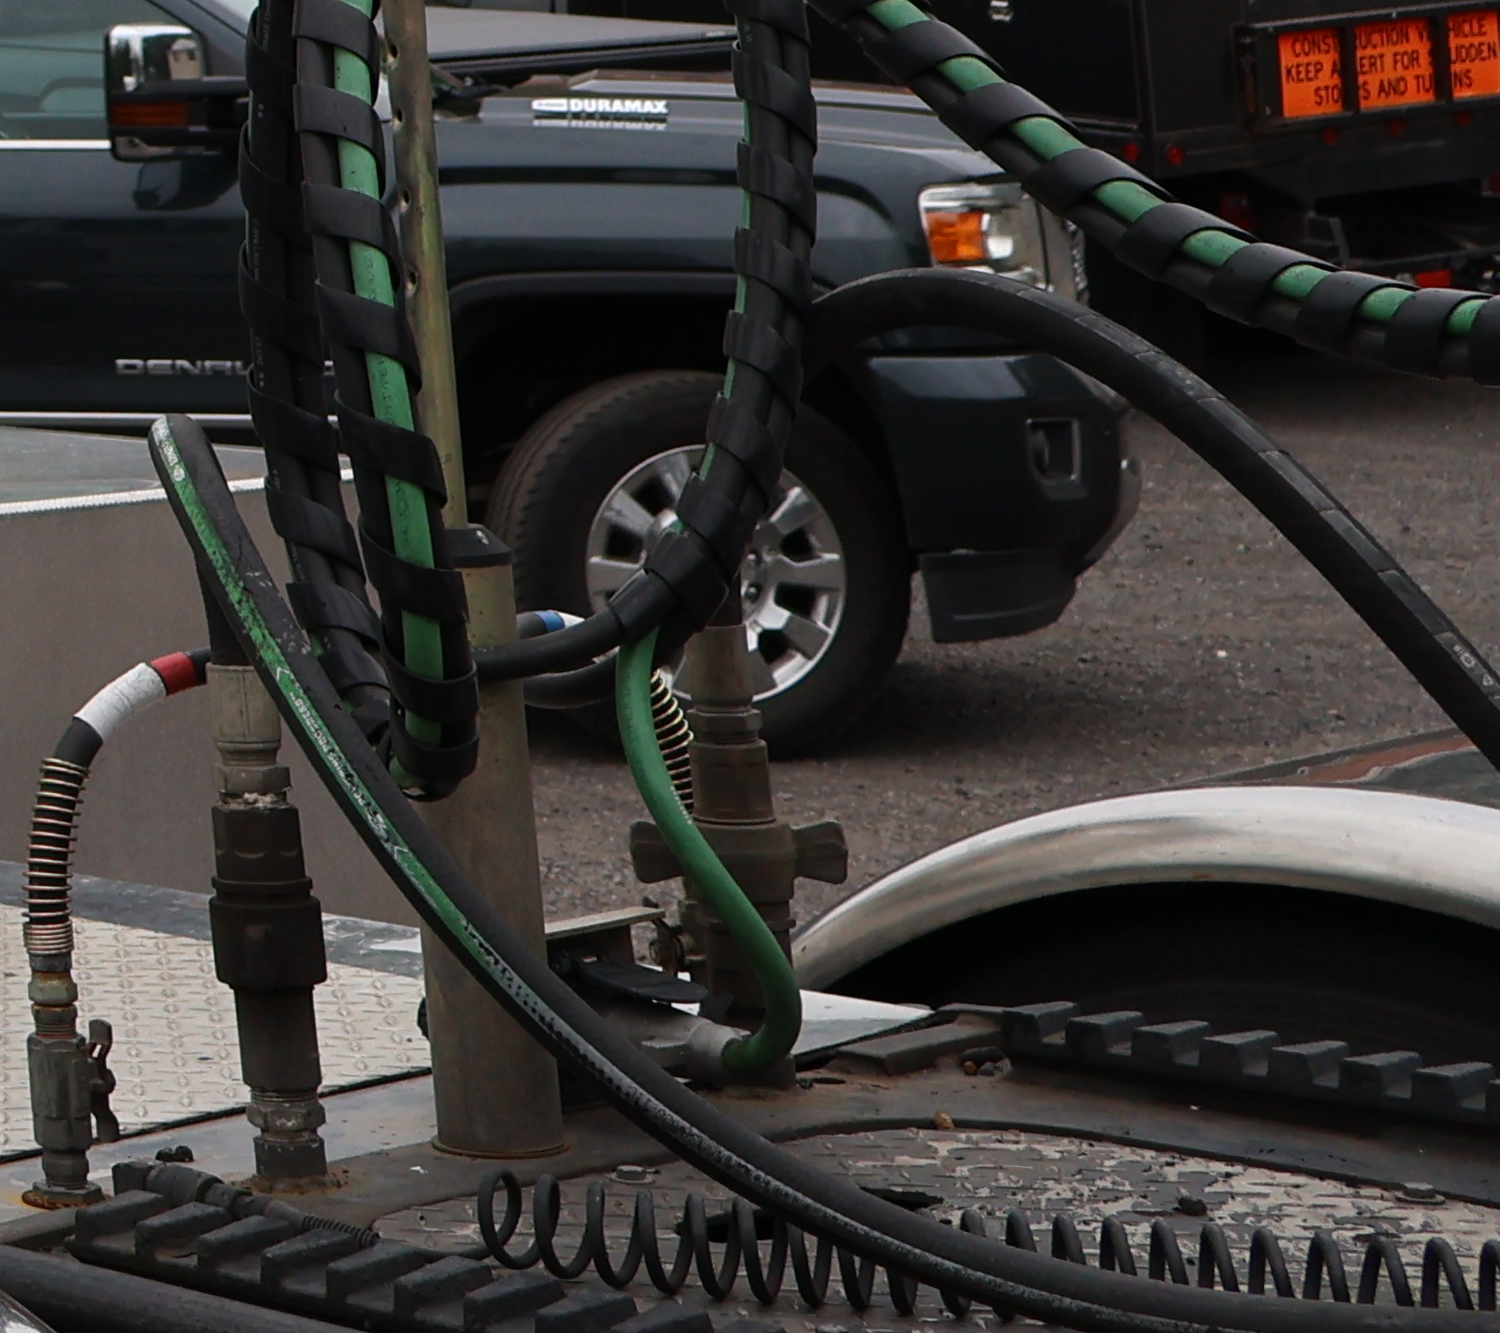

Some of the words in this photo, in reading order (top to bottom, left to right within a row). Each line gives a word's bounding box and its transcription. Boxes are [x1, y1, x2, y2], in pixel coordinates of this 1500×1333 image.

[1291, 26, 1410, 58] CONSTUCTION
[1285, 59, 1324, 83] KEEP
[1331, 53, 1386, 79] AERT
[1393, 49, 1421, 72] FOR
[1428, 42, 1498, 66] UDDEN
[1314, 80, 1371, 107] STOS
[1378, 76, 1408, 99] AND
[1414, 70, 1473, 94] TUNS
[569, 98, 669, 115] DURAMAX
[115, 359, 249, 376] DENAL
